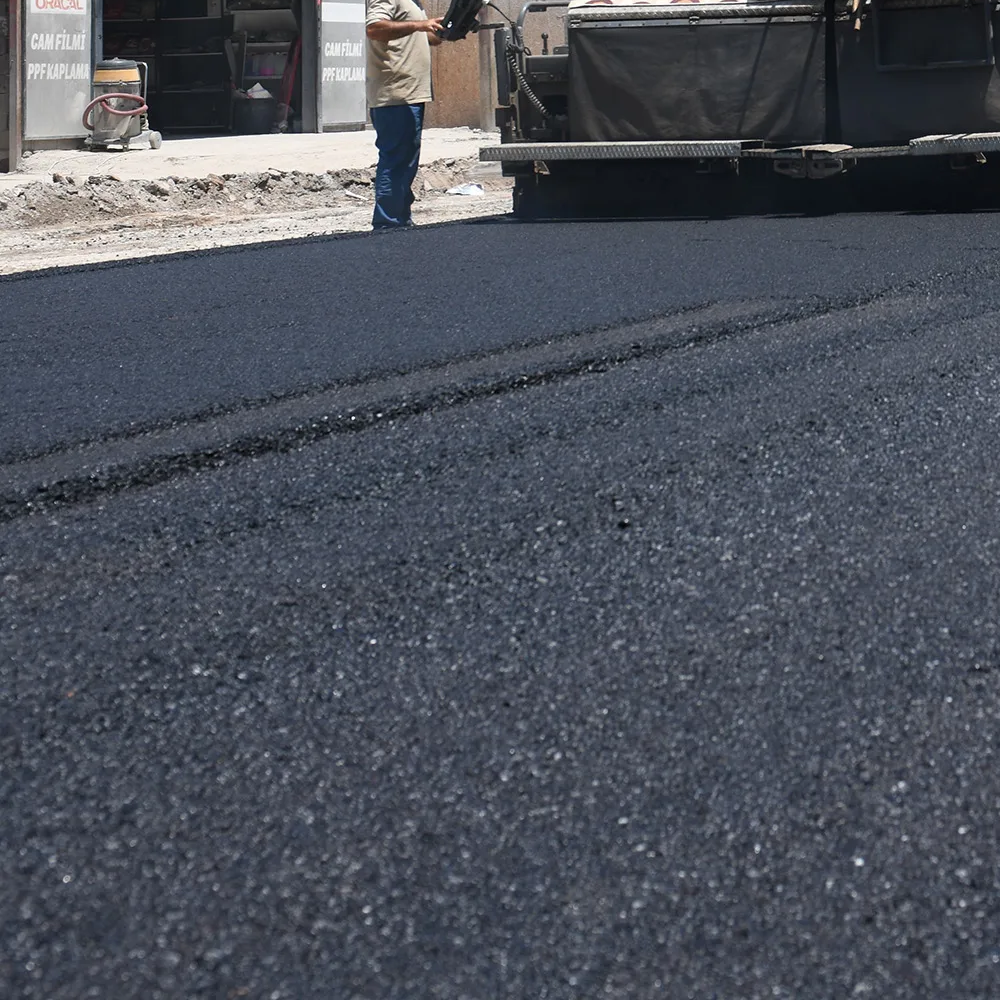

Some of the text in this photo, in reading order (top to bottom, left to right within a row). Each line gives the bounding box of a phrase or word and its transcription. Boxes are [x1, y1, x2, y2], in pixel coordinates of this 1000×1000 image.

[31, 29, 86, 50] CAM FİLMİ
[325, 42, 341, 57] CAM
[27, 63, 89, 80] PPF KAPLAMA
[322, 67, 366, 81] PPF KAPLAMA
